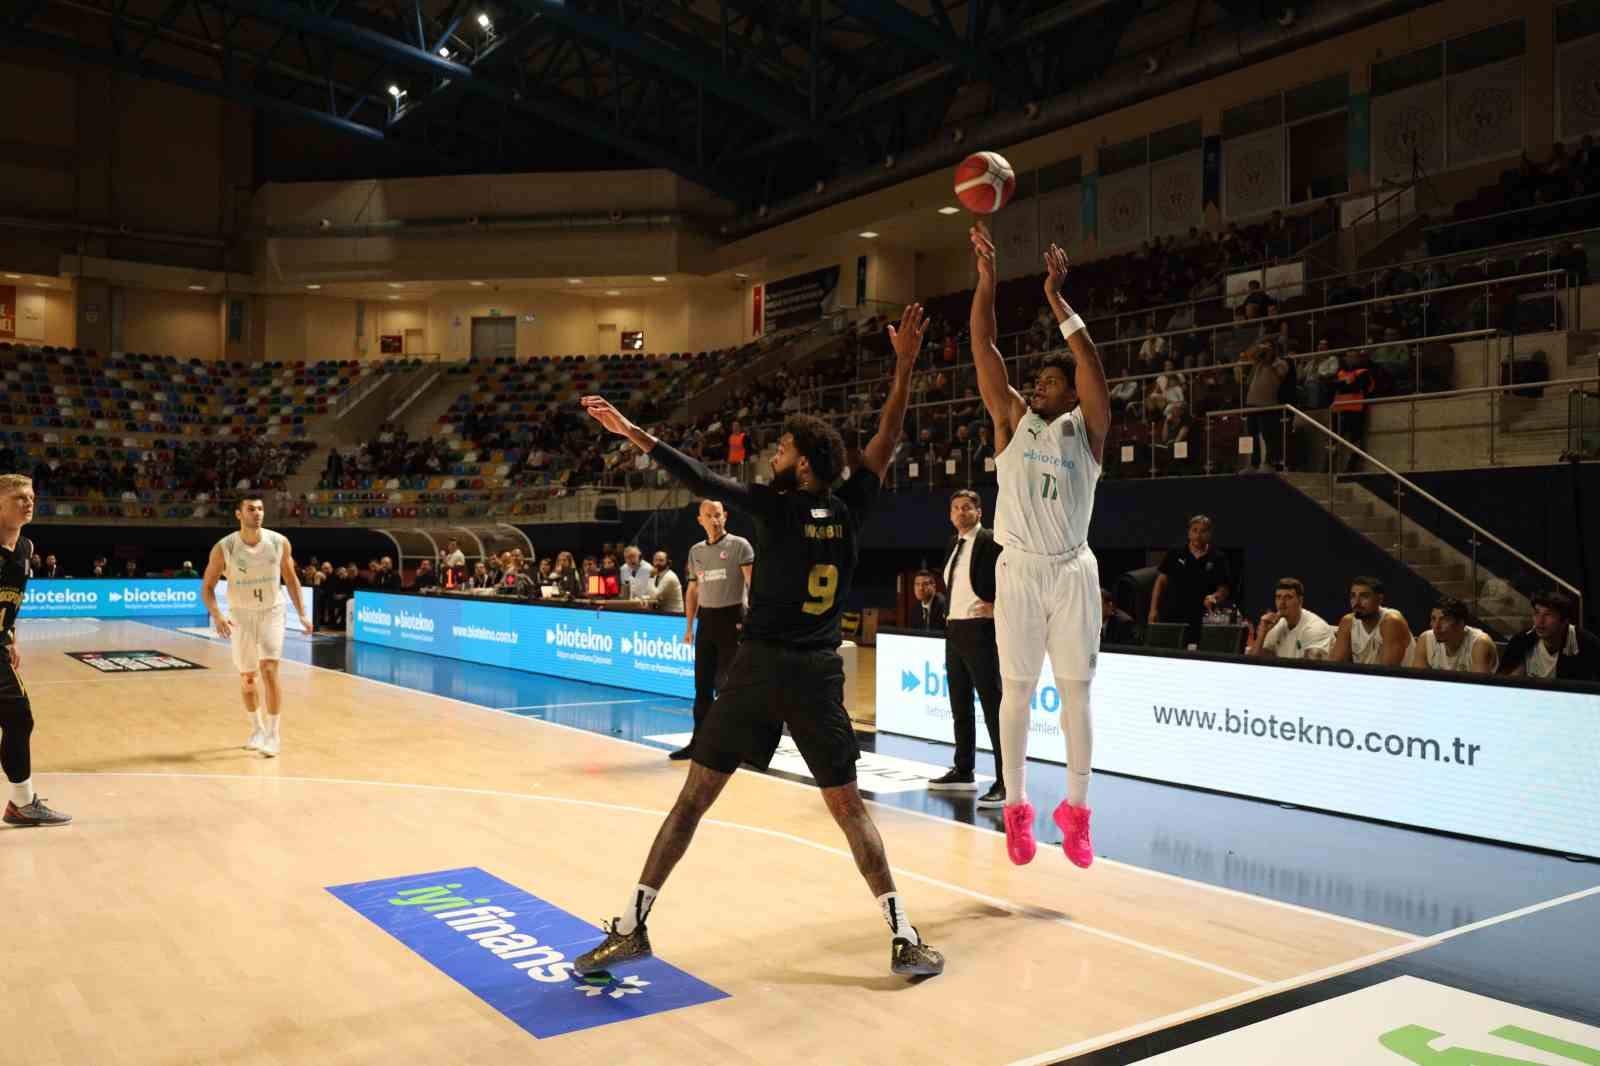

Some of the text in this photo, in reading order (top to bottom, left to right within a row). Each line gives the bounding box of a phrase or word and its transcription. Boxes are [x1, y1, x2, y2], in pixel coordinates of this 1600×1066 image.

[124, 587, 196, 602] biotekno
[253, 588, 263, 602] 4
[802, 564, 838, 615] 9
[556, 623, 613, 652] biotekno
[633, 631, 695, 662] biotekn
[1153, 704, 1481, 766] www.biotekno.com.tr
